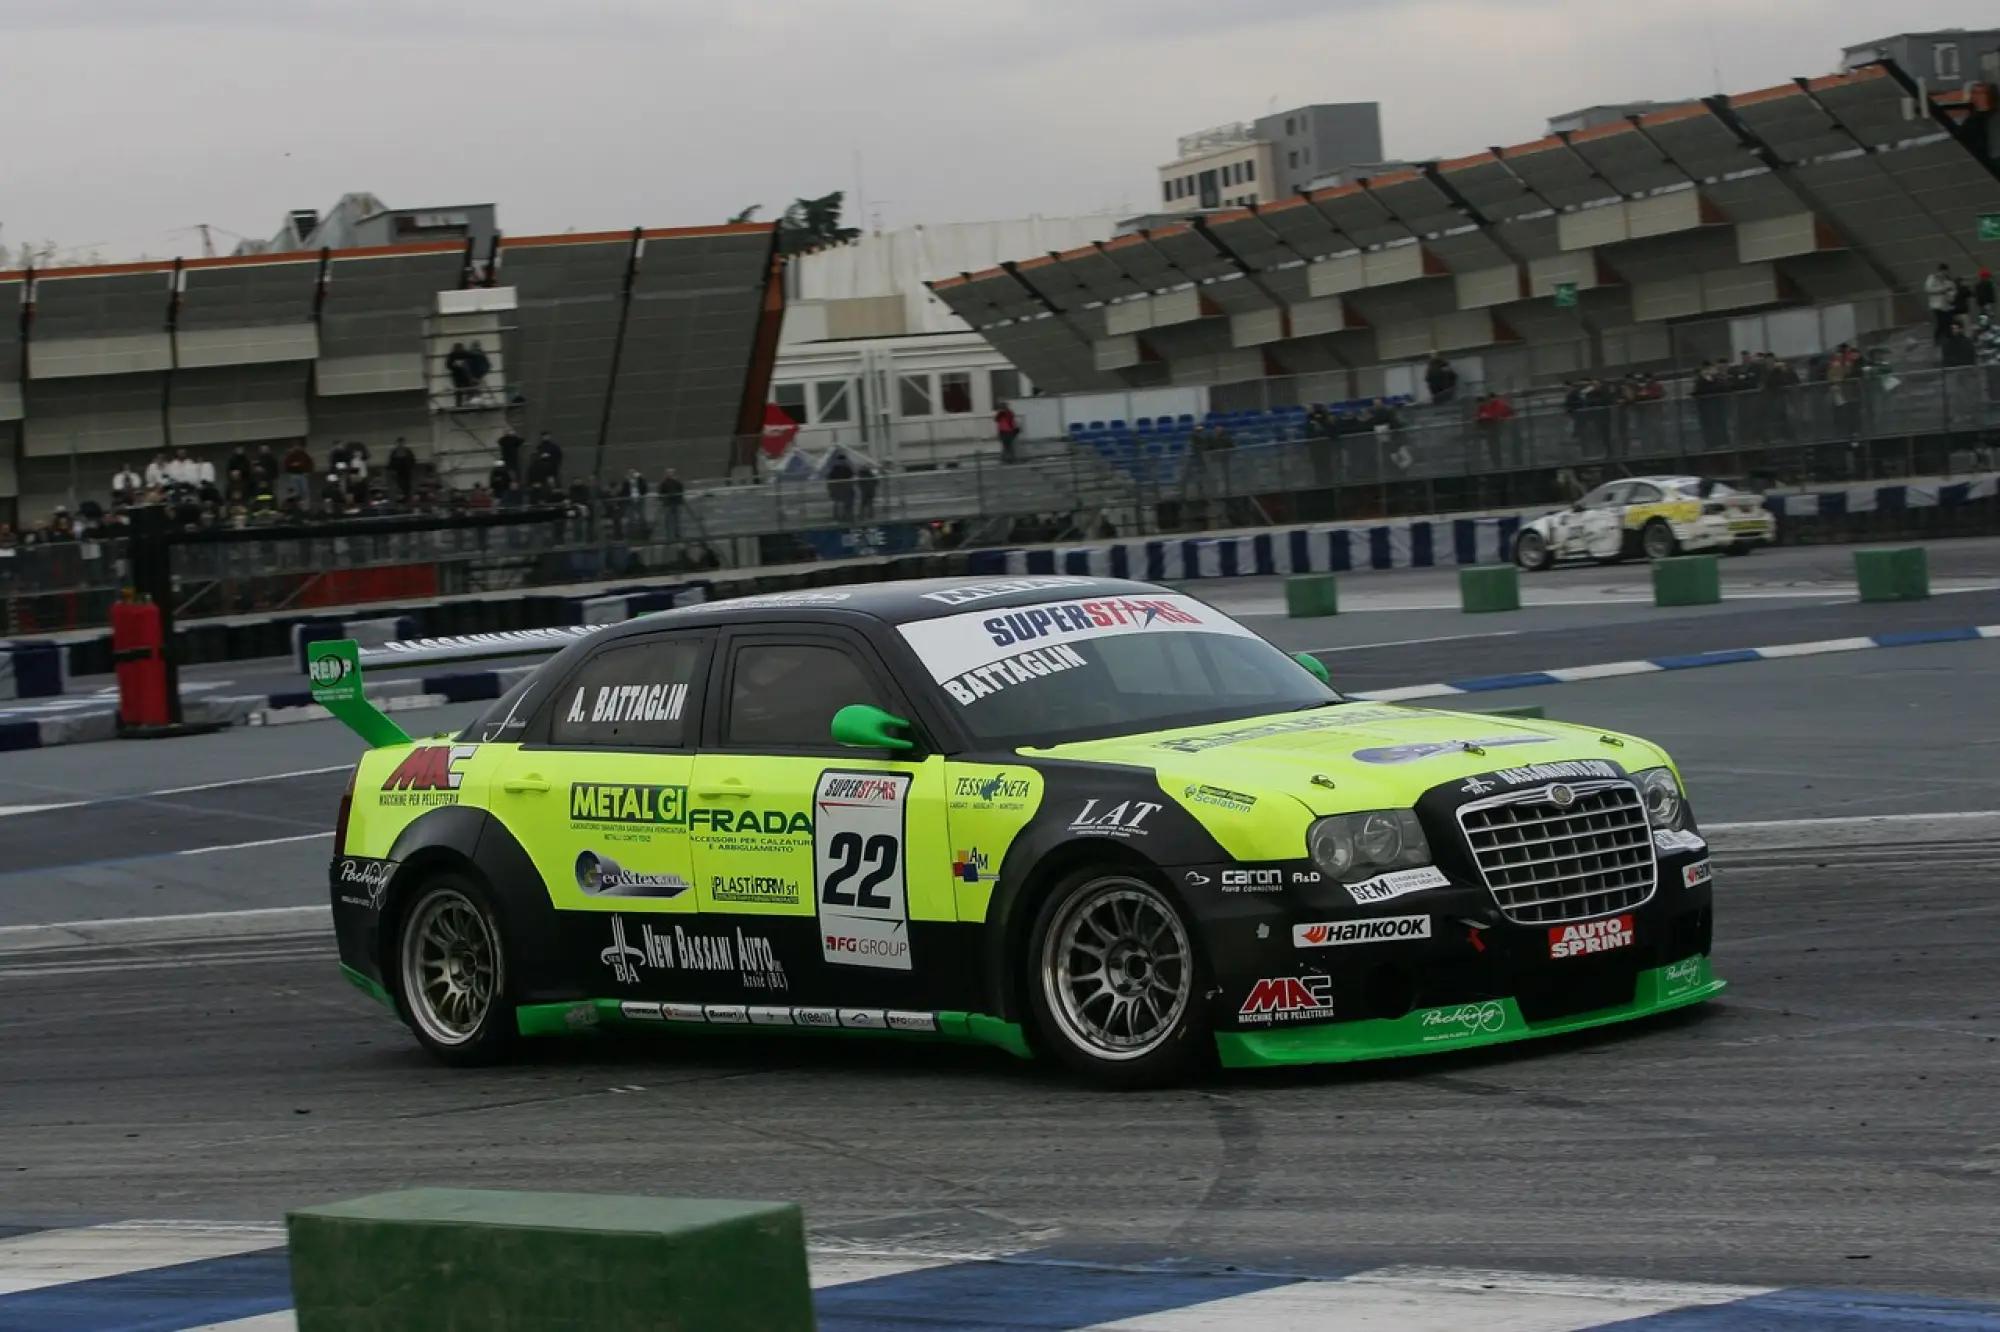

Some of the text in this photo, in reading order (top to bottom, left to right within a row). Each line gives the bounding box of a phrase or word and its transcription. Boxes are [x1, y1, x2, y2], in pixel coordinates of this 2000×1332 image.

[943, 645, 1088, 706] BATTAGLIN
[566, 684, 688, 722] A. BATTAGLIN
[381, 745, 479, 790] MAC
[688, 808, 813, 835] FRADA
[1070, 799, 1163, 828] LAT
[822, 832, 899, 909] 22
[1221, 869, 1282, 885] caron
[1551, 930, 1633, 958] SPRINT
[1562, 919, 1623, 942] AUTO
[736, 925, 774, 972] AUTO
[1239, 976, 1334, 1013] MAC
[1239, 1008, 1335, 1023] MACCHINE PER PELLETTERIA
